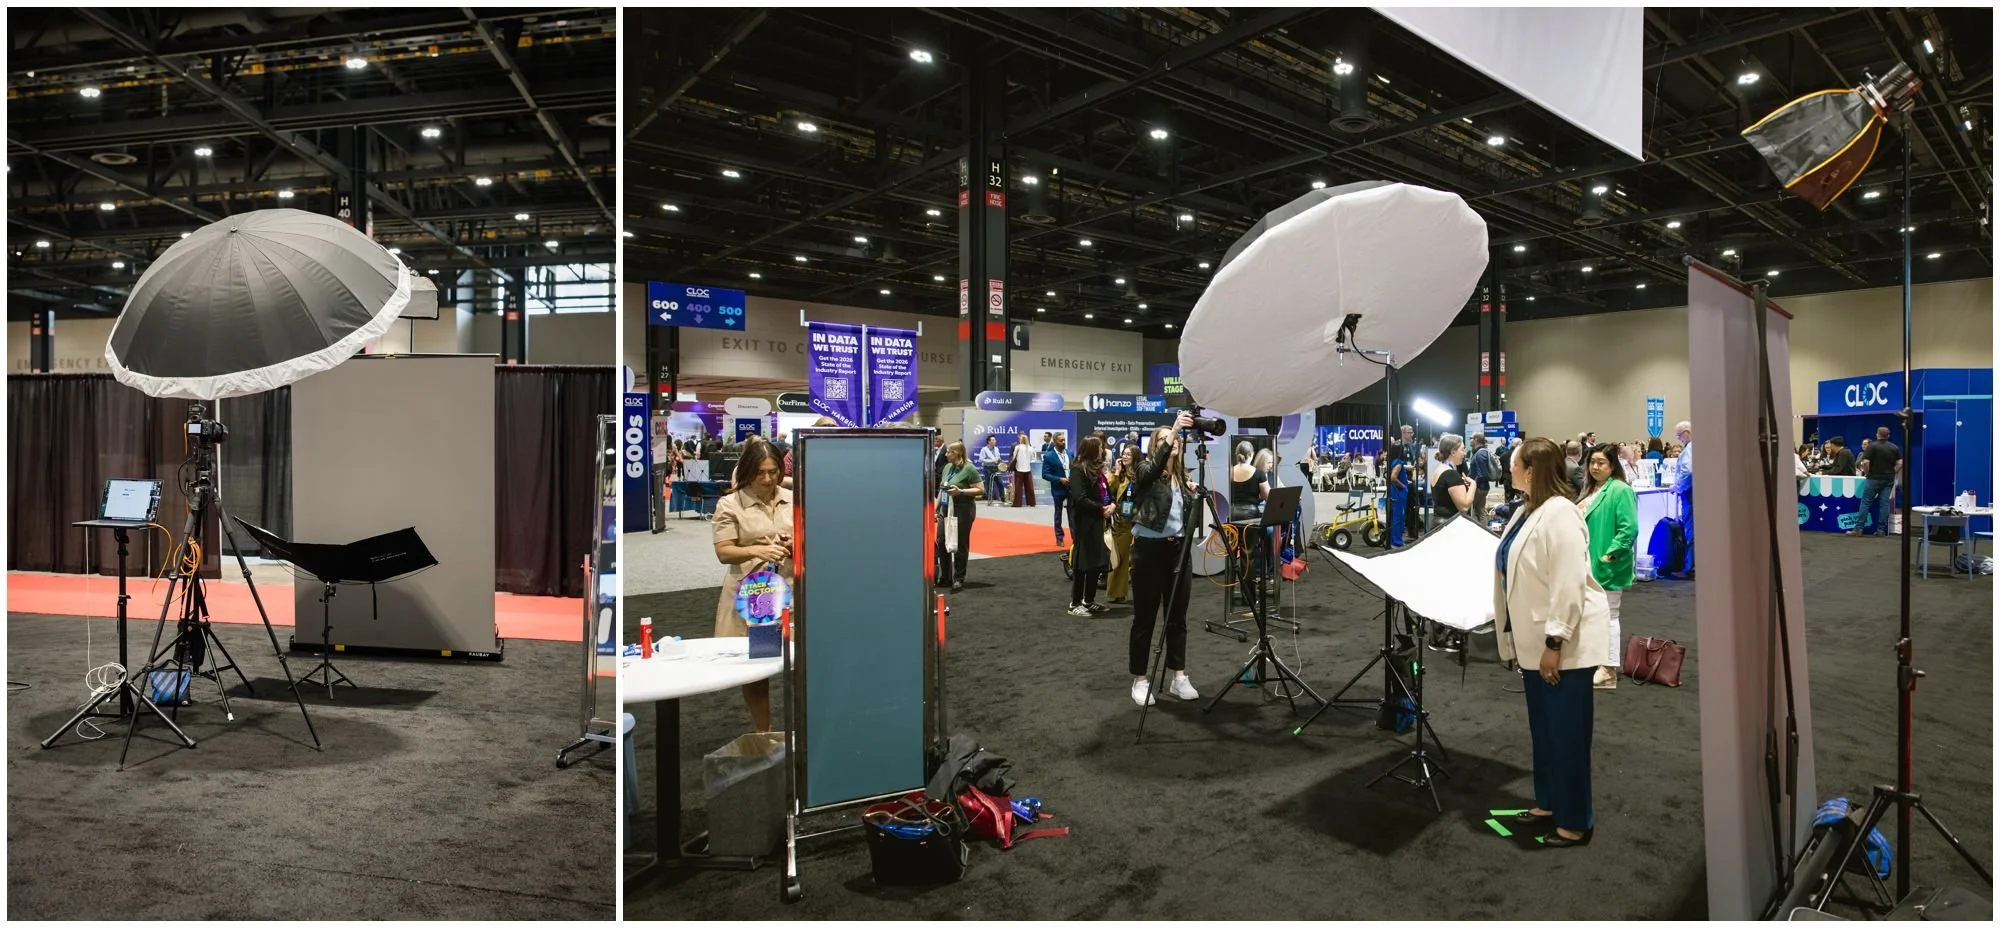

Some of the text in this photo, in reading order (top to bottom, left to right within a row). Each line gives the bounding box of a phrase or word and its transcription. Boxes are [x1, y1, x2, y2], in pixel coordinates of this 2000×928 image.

[992, 162, 999, 173] H
[989, 175, 1002, 187] 32
[340, 196, 349, 207] H
[338, 209, 350, 218] 40
[686, 287, 710, 296] CLOC
[652, 300, 743, 316] 600 400 500
[812, 333, 858, 345] IN DATA
[870, 336, 913, 348] IN DATA
[722, 337, 760, 351] EXIT
[766, 341, 787, 353] TO
[813, 343, 829, 352] WE
[829, 344, 858, 354] TRUST
[886, 348, 913, 356] TRUST
[1041, 357, 1133, 373] EMERGENCY EXIT
[1163, 385, 1184, 393] STAGE
[1845, 381, 1889, 407] CLOC
[625, 397, 643, 405] CLOC
[1106, 399, 1132, 408] hanzo
[987, 425, 1018, 434] Ruli AI
[625, 414, 644, 478] 600s
[740, 582, 767, 591] ATTACK
